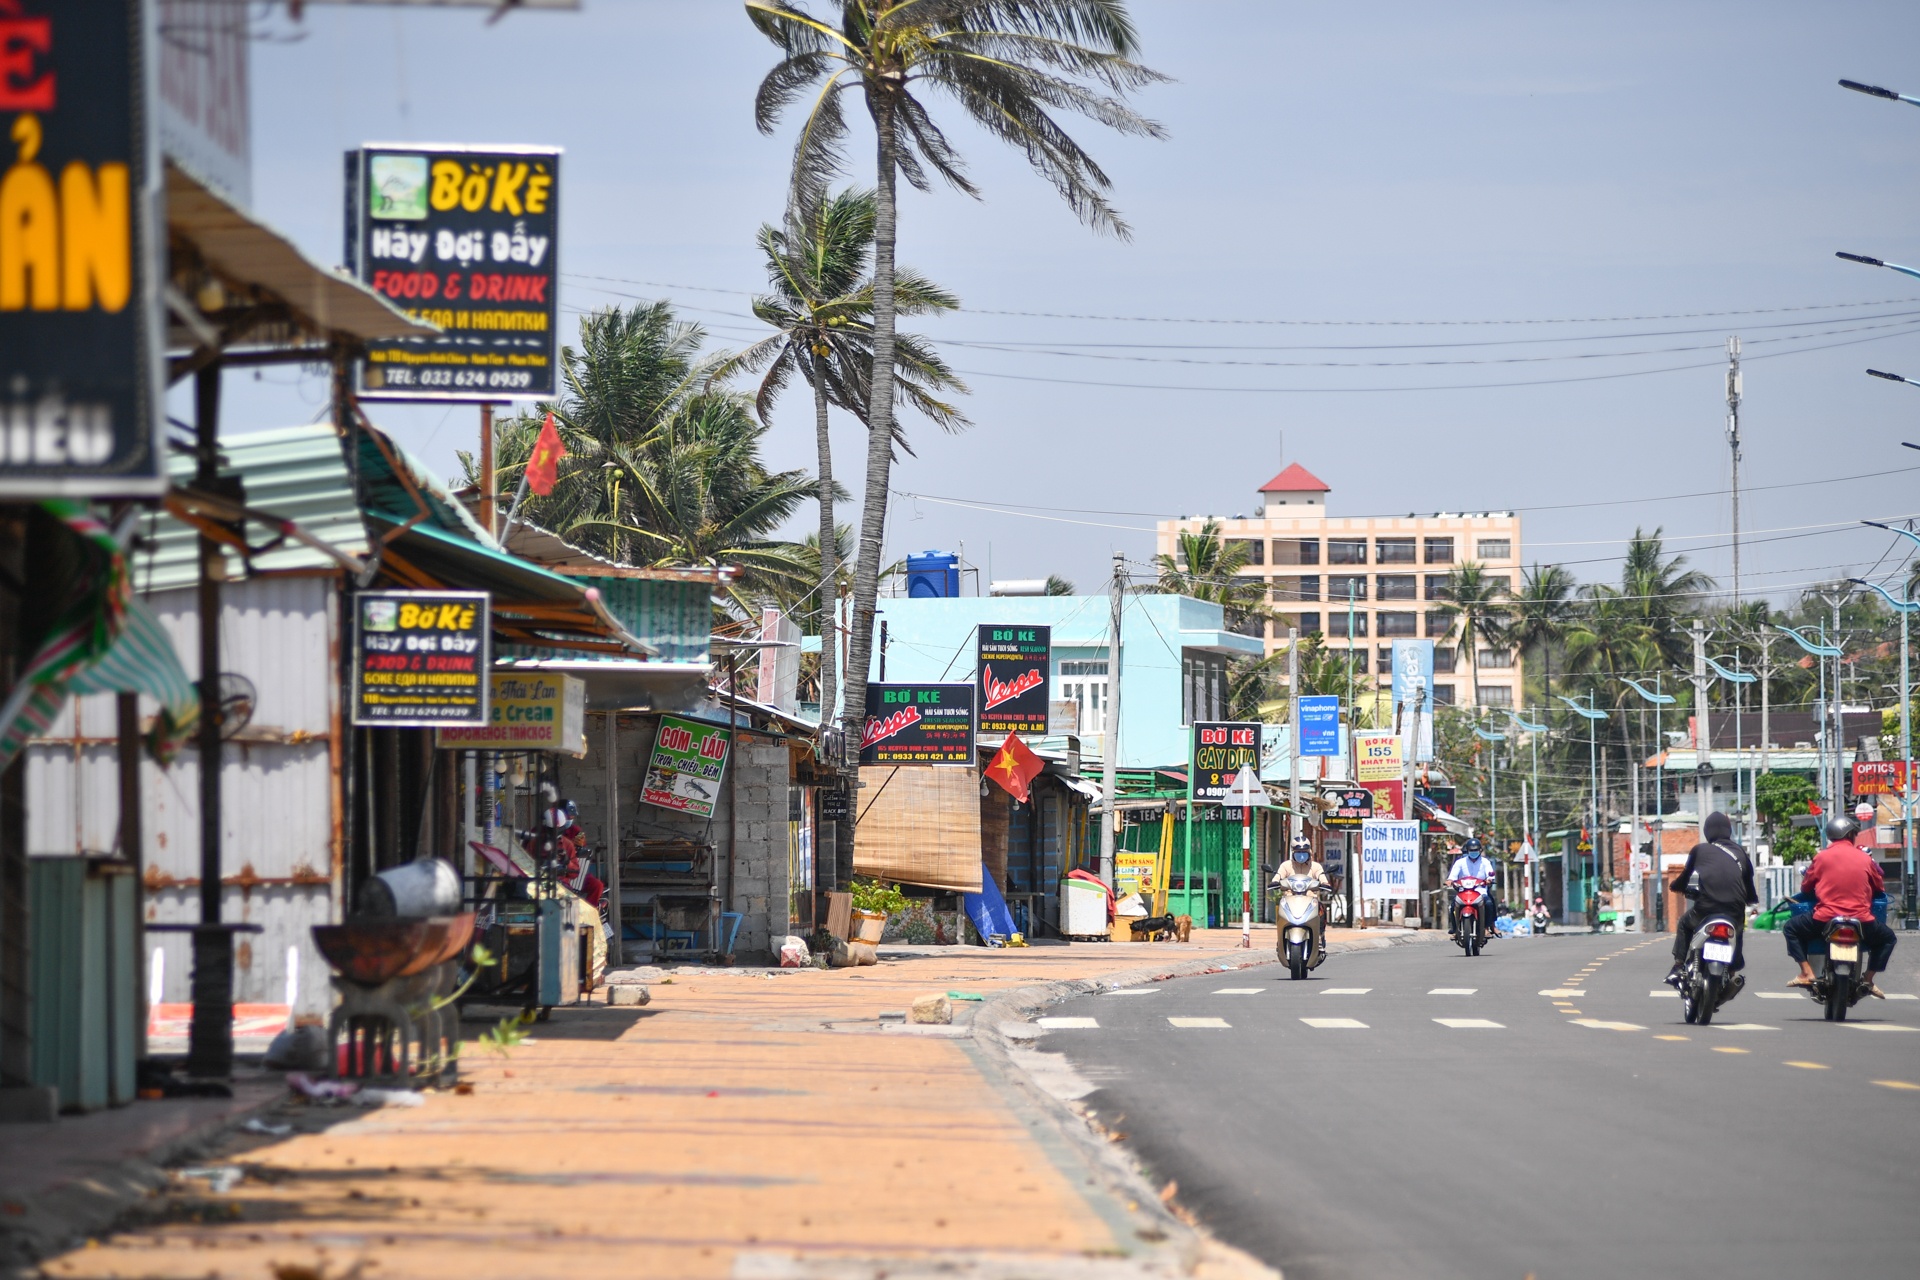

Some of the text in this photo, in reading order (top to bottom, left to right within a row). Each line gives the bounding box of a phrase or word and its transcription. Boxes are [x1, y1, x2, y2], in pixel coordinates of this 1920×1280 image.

[372, 271, 548, 303] FOOD & DRINK
[472, 311, 547, 331] НАПИТКИ
[386, 369, 530, 387] TEL: 033 624 0939
[992, 629, 1035, 641] BỜ KÈ
[366, 655, 408, 670] FOOD
[426, 656, 475, 671] DRINK
[428, 674, 477, 685] НАПИТКИ
[984, 663, 1043, 711] Vespa
[883, 689, 940, 703] BỜ KÈ
[394, 707, 415, 715] 033
[417, 708, 438, 716] 624
[441, 708, 469, 716] 0939
[507, 705, 554, 721] Cream
[442, 726, 509, 741] МОРОЖЕНОЕ
[992, 722, 1006, 730] 0933
[1007, 723, 1017, 731] 491
[1018, 723, 1028, 731] 421
[659, 726, 692, 753] CƠM
[699, 732, 726, 759] LẨU
[1202, 727, 1254, 745] BỜ KÈ
[1197, 745, 1226, 770] CÂY
[1368, 747, 1392, 756] 155
[653, 754, 674, 767] TRƯA
[702, 764, 719, 778] ĐÊM
[1857, 763, 1895, 773] OPTICS
[1140, 811, 1155, 821] TEA
[1364, 825, 1417, 841] CƠM TRƯA
[1364, 847, 1387, 862] CƠM
